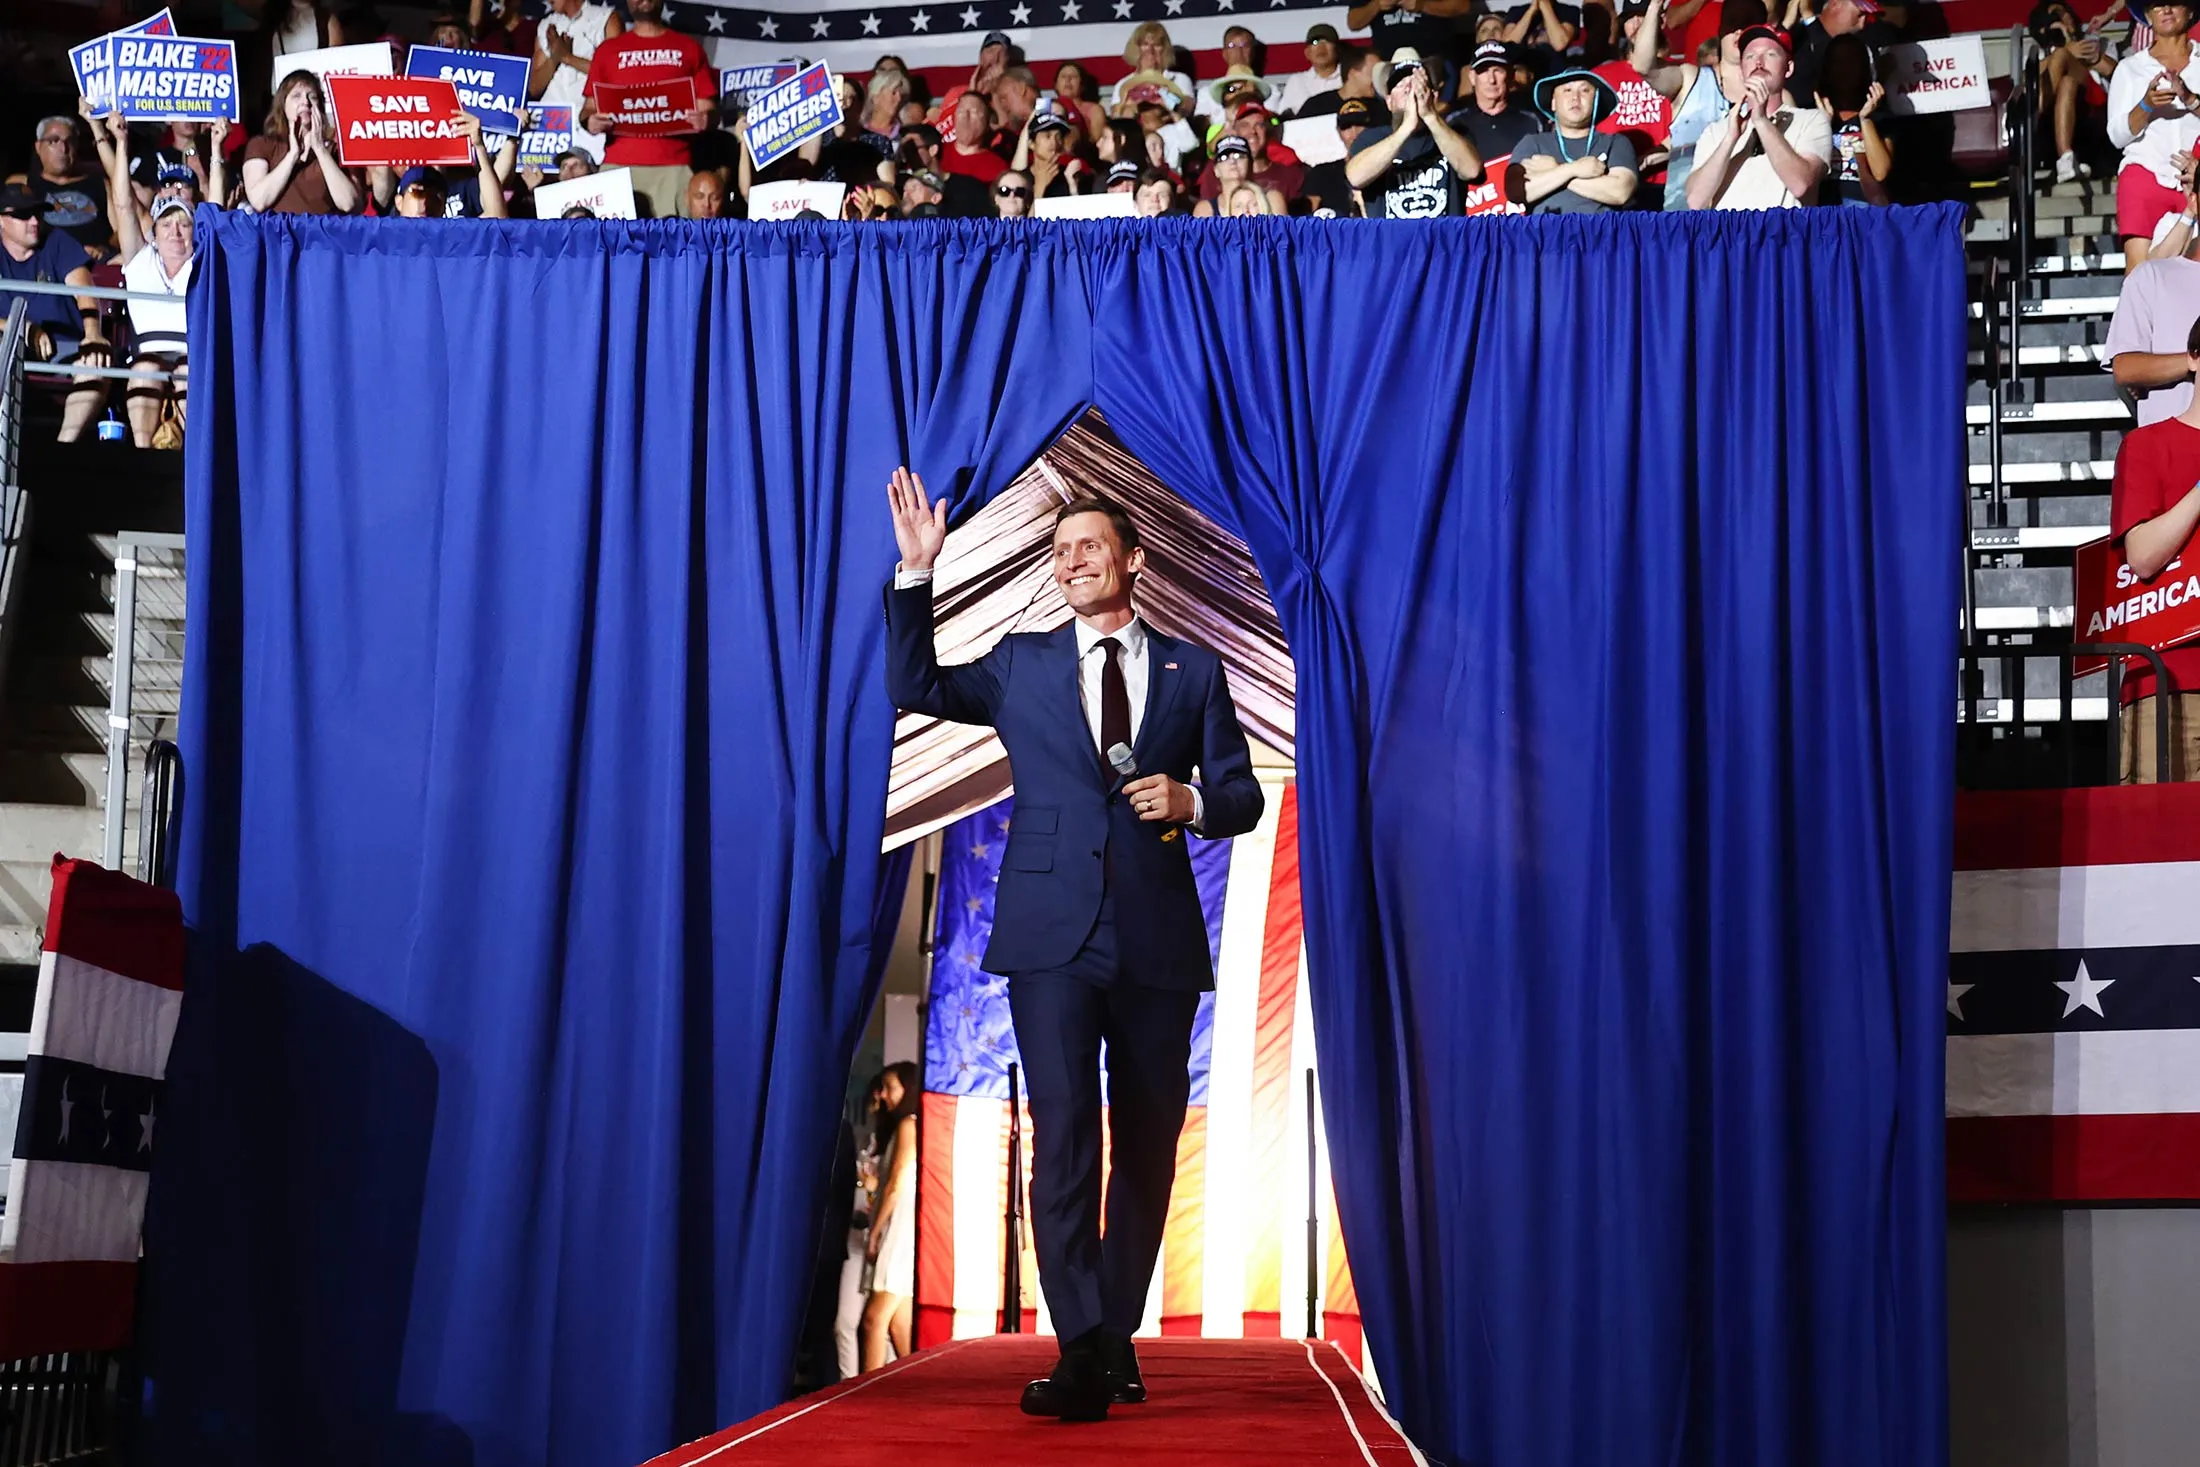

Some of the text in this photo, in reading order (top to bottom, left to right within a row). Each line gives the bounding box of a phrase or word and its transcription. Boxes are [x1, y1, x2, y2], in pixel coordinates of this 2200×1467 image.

[118, 40, 231, 71] BLAKE '22
[618, 49, 683, 63] TRUMP
[1912, 57, 1956, 74] SAVE
[118, 70, 233, 99] MASTERS
[439, 66, 496, 88] SAVE
[725, 67, 774, 92] BLAKE
[1898, 74, 1979, 95] AMERICA!
[135, 99, 213, 112] FOR U.S. SENATE
[369, 95, 431, 114] SAVE
[458, 89, 516, 114] RICA!
[622, 95, 669, 110] SAVE
[746, 79, 802, 126] BLAKE
[1616, 99, 1663, 115] GREAT
[751, 88, 832, 151] MASTERS
[793, 117, 822, 137] SENATE
[1616, 111, 1661, 126] AGAIN
[523, 154, 553, 166] SENATE
[771, 199, 811, 213] SAVE
